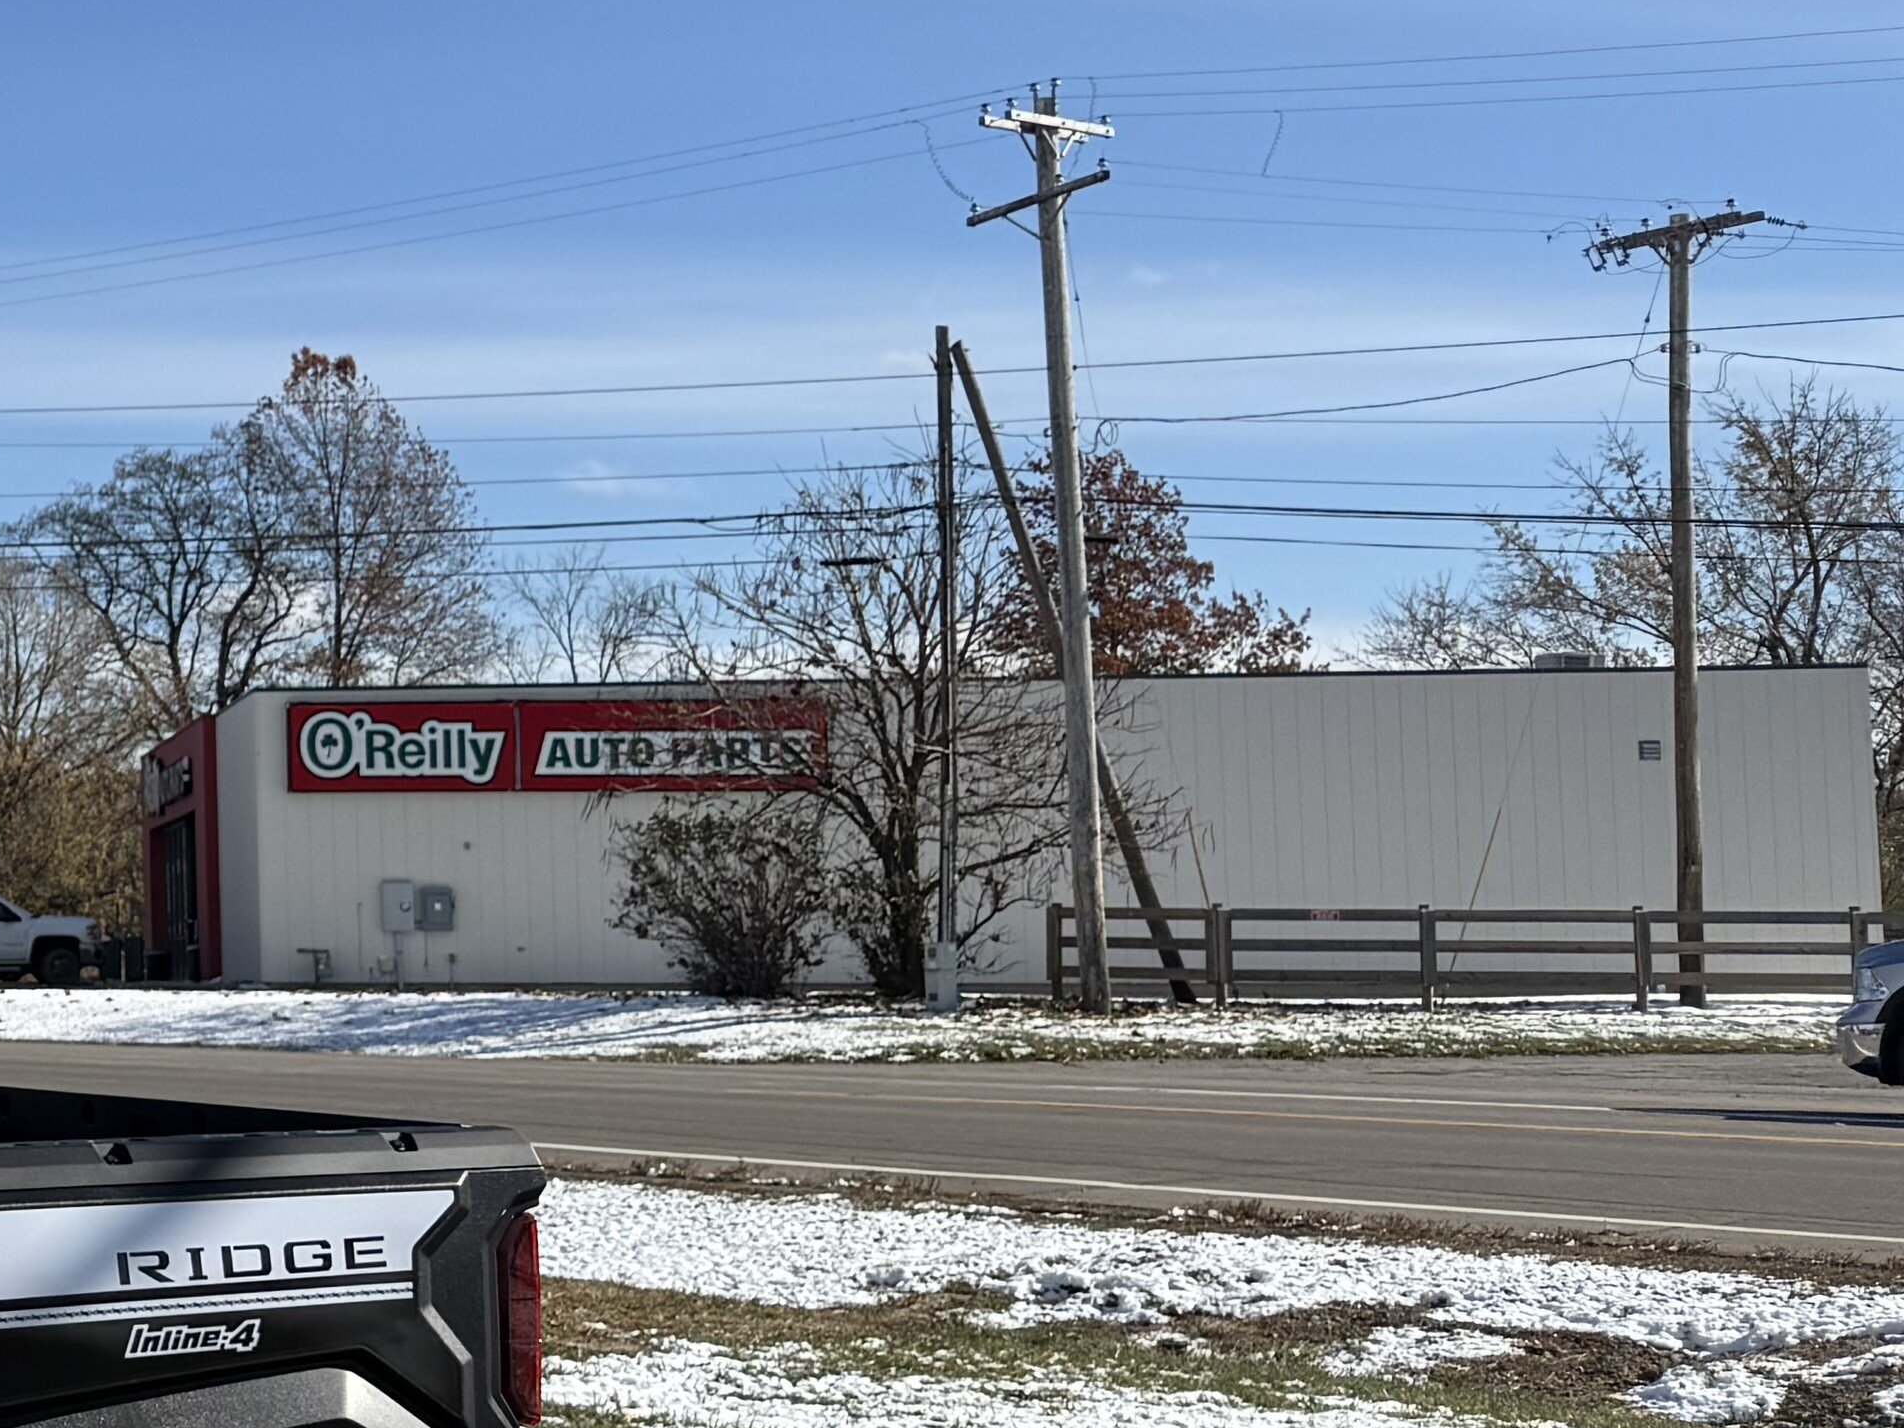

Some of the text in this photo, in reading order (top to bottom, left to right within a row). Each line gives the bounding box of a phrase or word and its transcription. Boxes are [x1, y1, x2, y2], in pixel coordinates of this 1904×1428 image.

[300, 711, 506, 784] O'Reilly
[545, 737, 655, 769] AUTO
[116, 1235, 387, 1286] RIDGE
